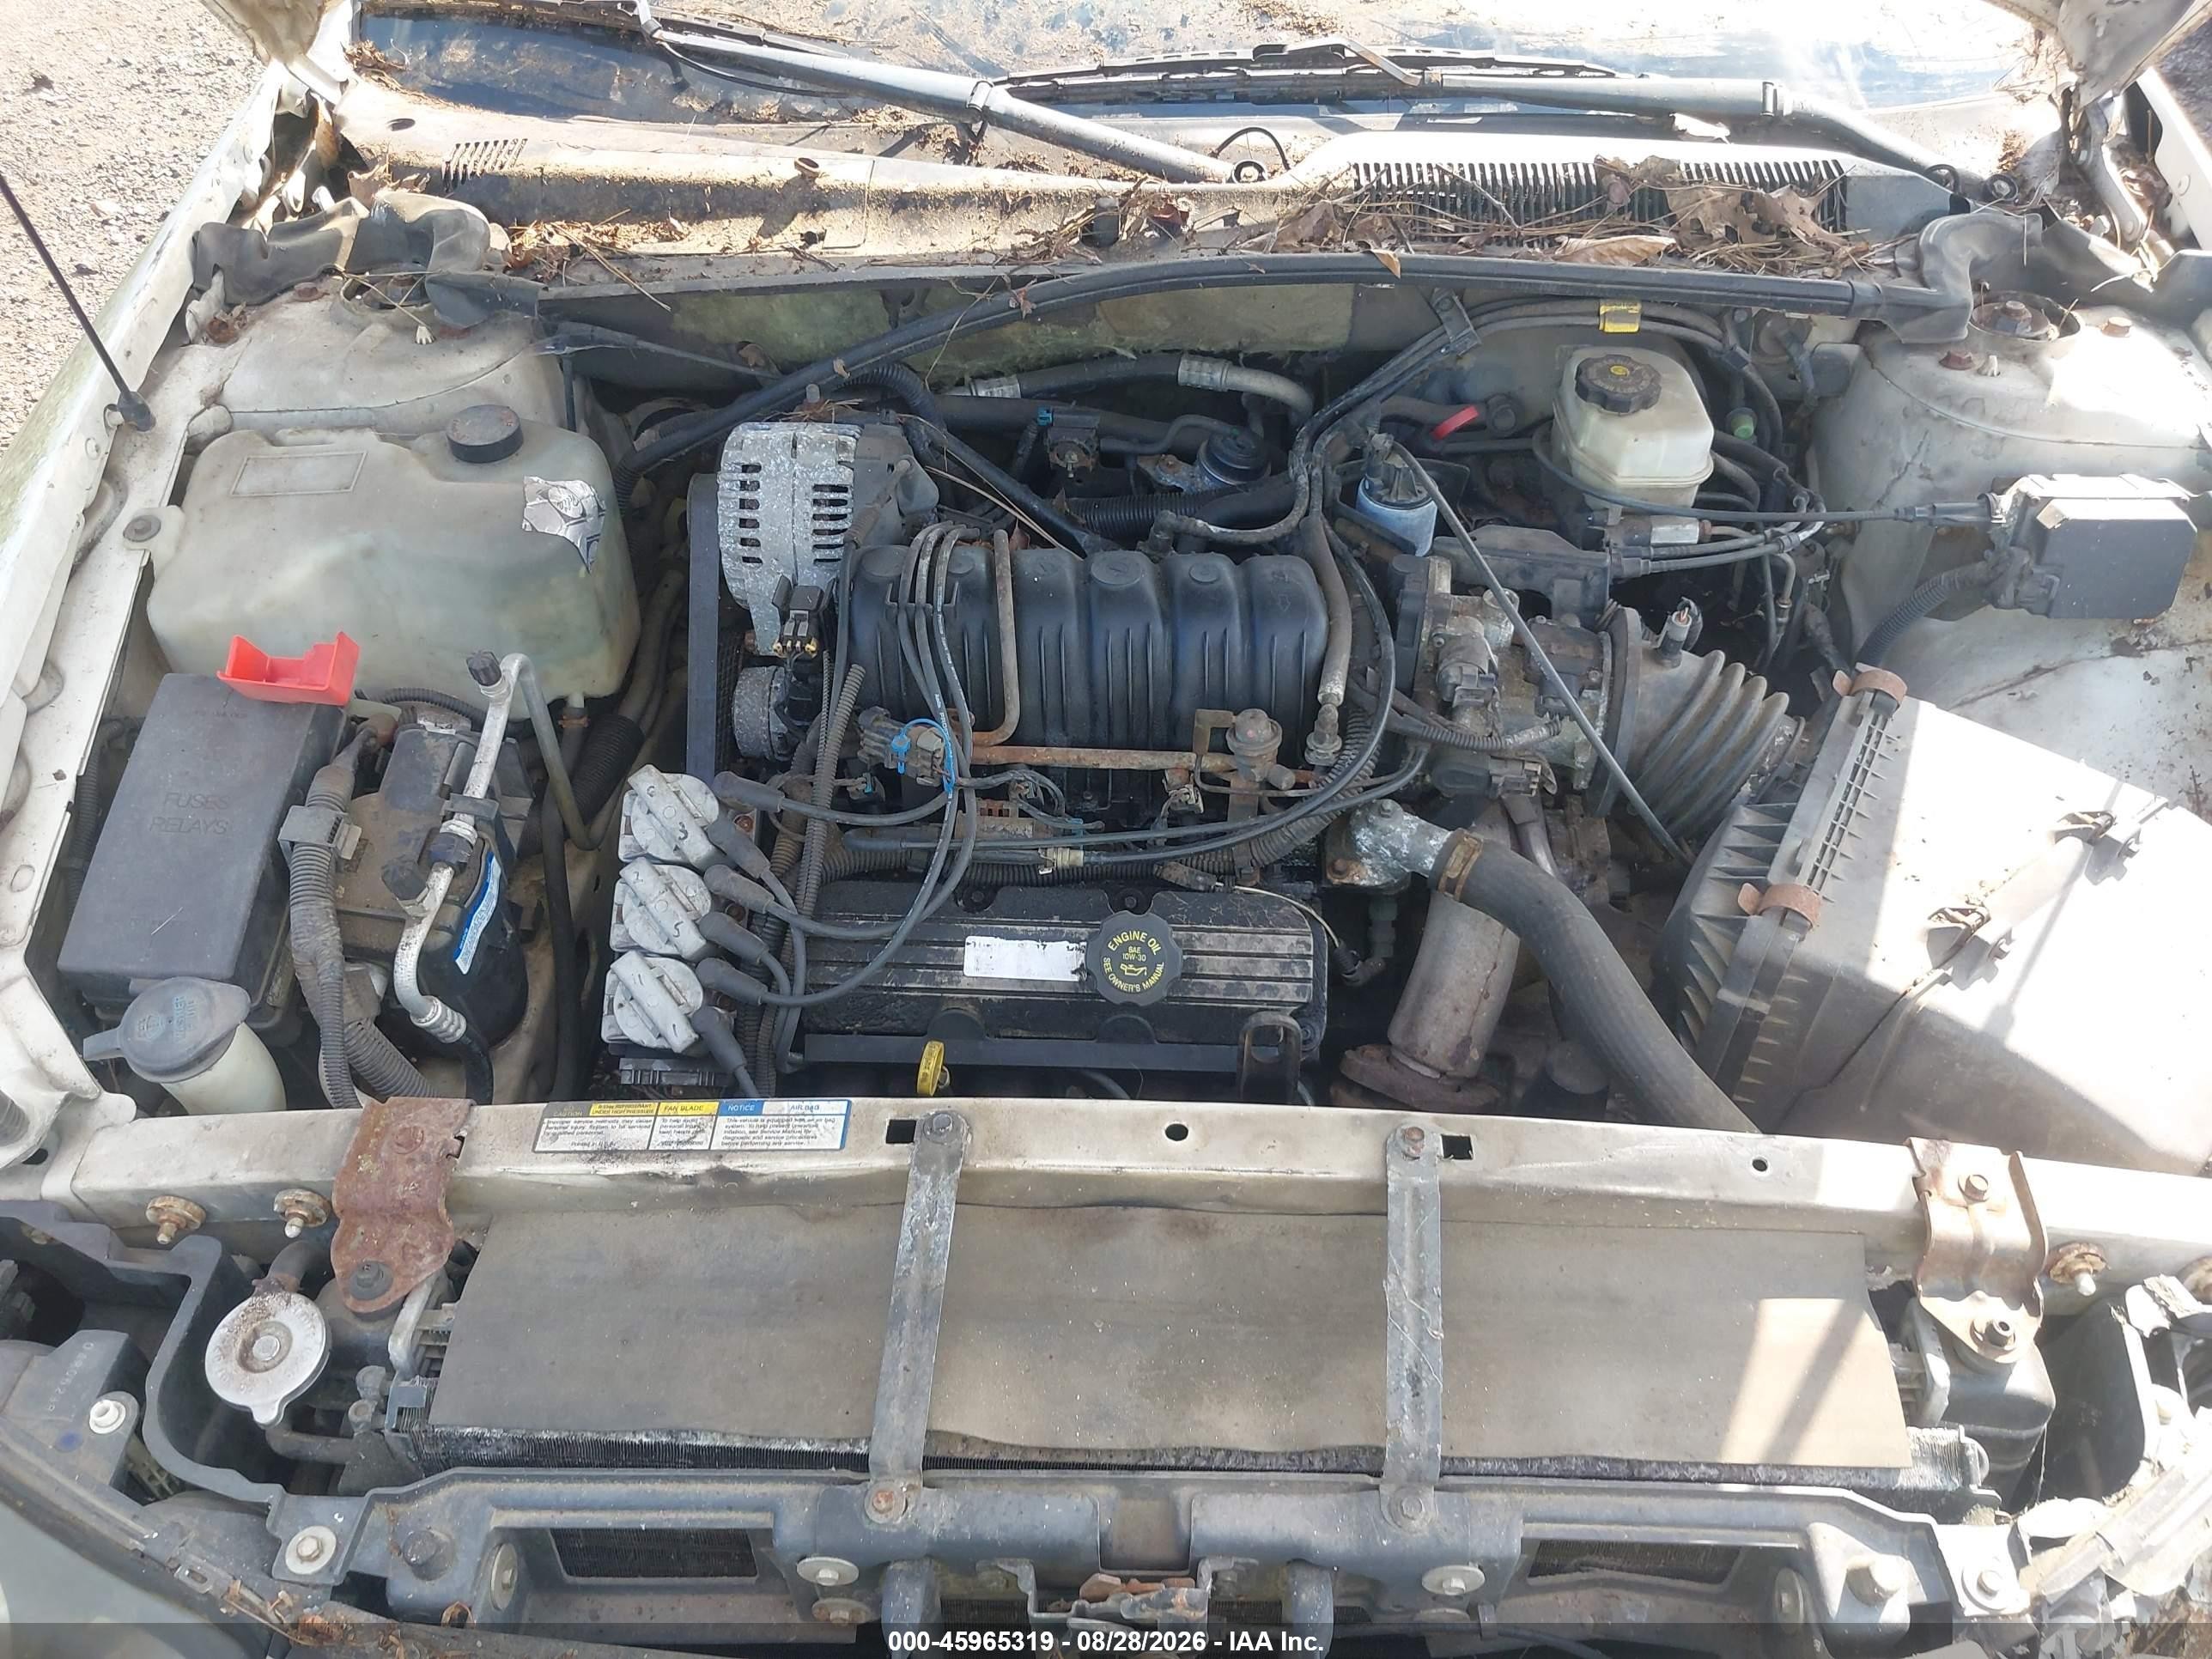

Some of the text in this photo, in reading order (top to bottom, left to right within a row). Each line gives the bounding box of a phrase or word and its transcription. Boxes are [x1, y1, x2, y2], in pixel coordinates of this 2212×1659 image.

[163, 792, 231, 811] FUSES
[149, 816, 230, 836] RELAYS
[677, 821, 690, 842] 3
[672, 920, 685, 939] 5
[1108, 930, 1148, 951] ENGINE
[1147, 938, 1162, 955] OIL
[1122, 953, 1146, 962] 10W-30
[1103, 957, 1164, 993] SEE OWNER'S MANUAL
